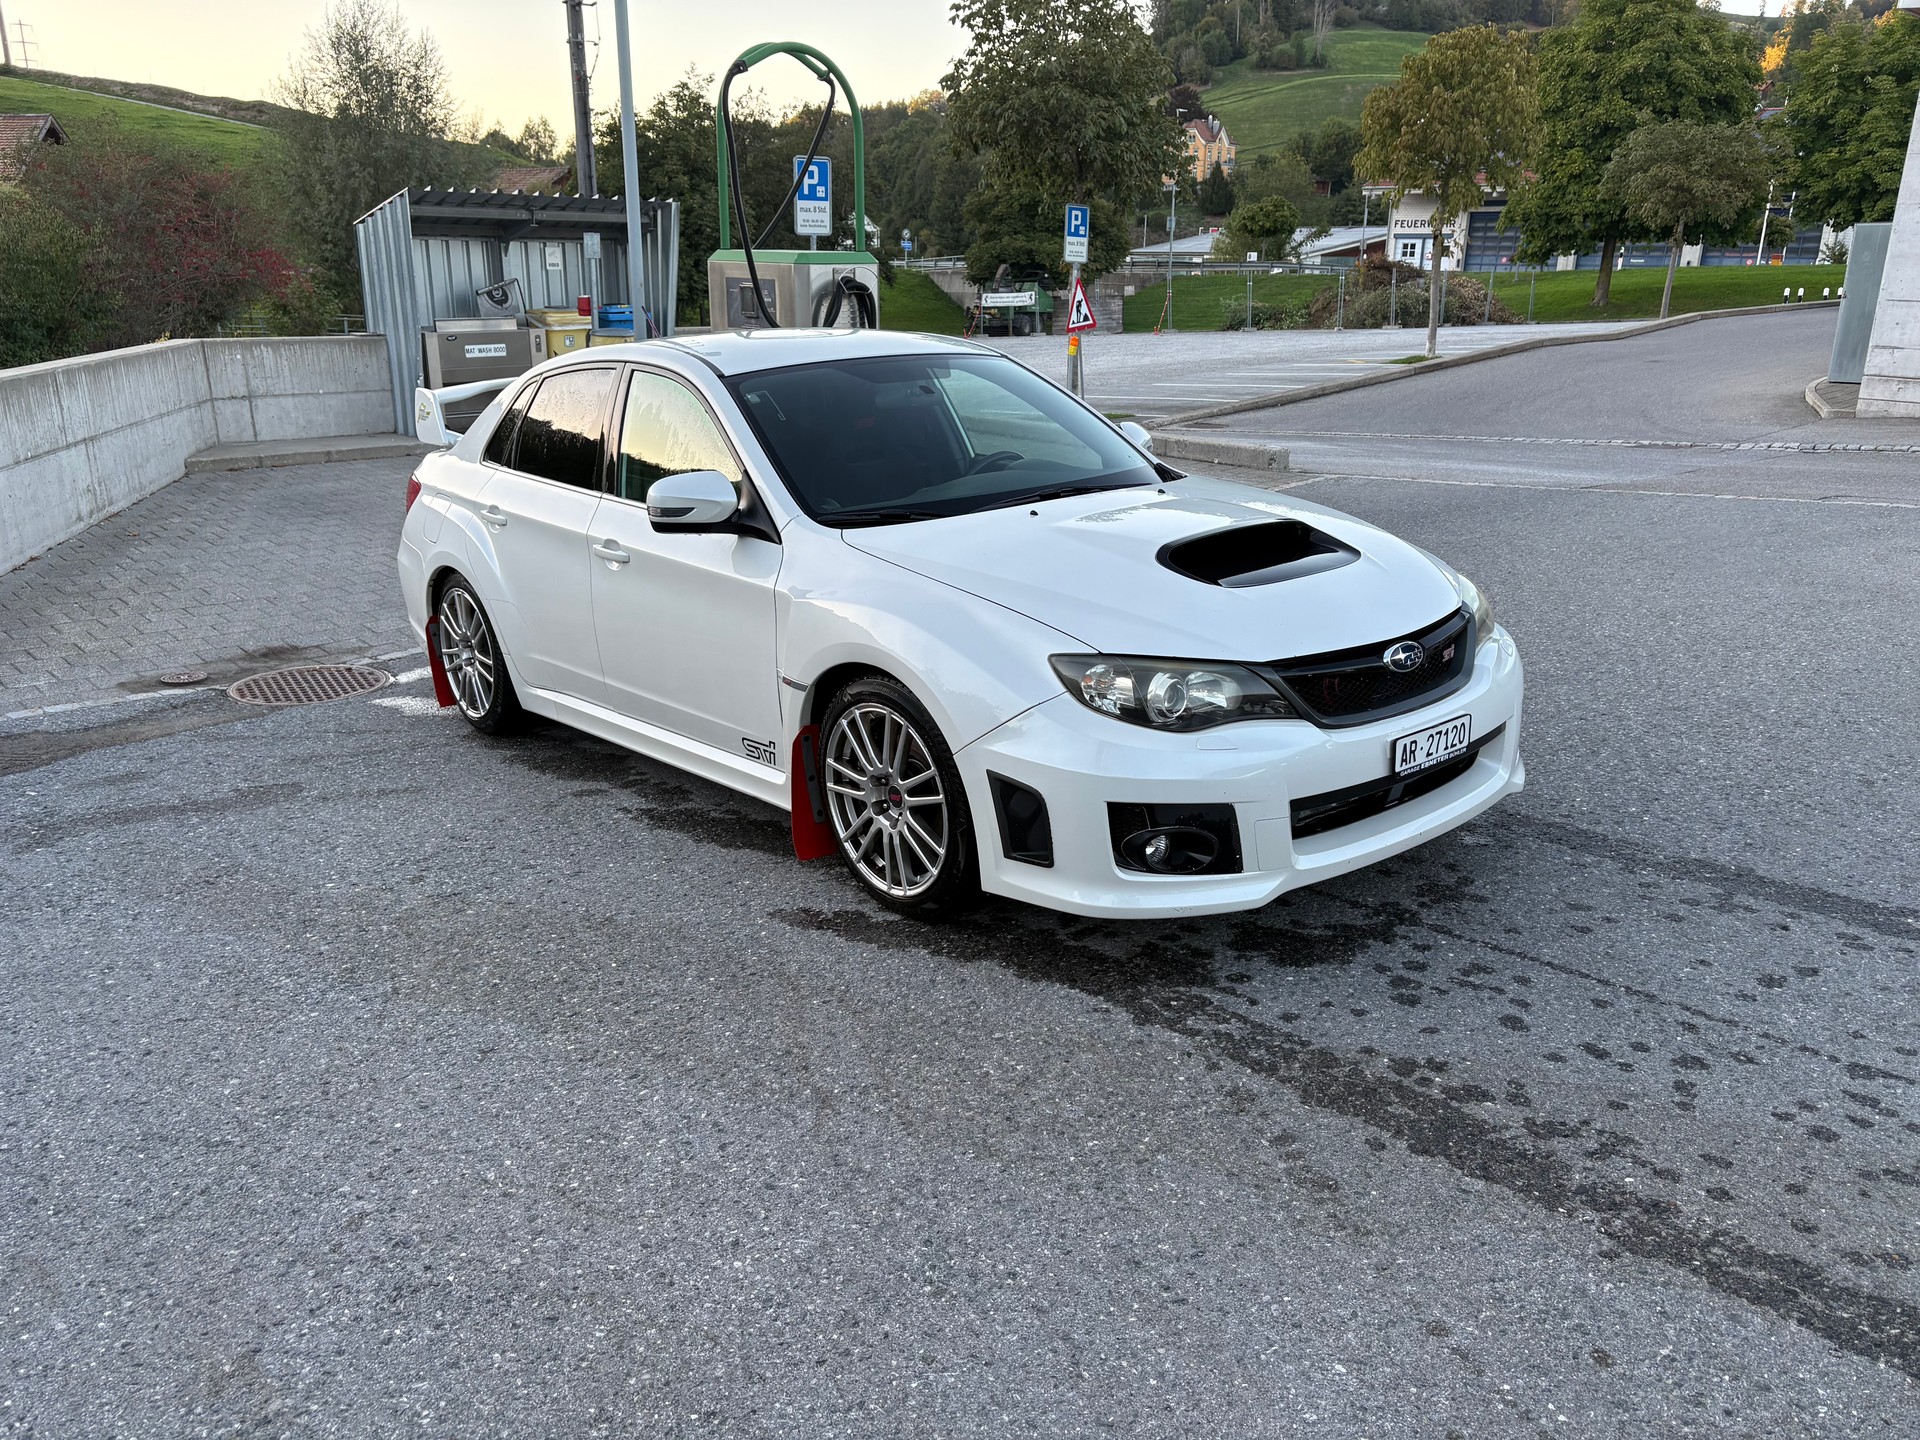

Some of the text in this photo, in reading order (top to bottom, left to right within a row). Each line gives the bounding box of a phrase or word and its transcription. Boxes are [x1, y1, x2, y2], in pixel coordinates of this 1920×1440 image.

[803, 165, 819, 195] P
[1071, 210, 1081, 232] P
[1400, 766, 1420, 777] GARAGE
